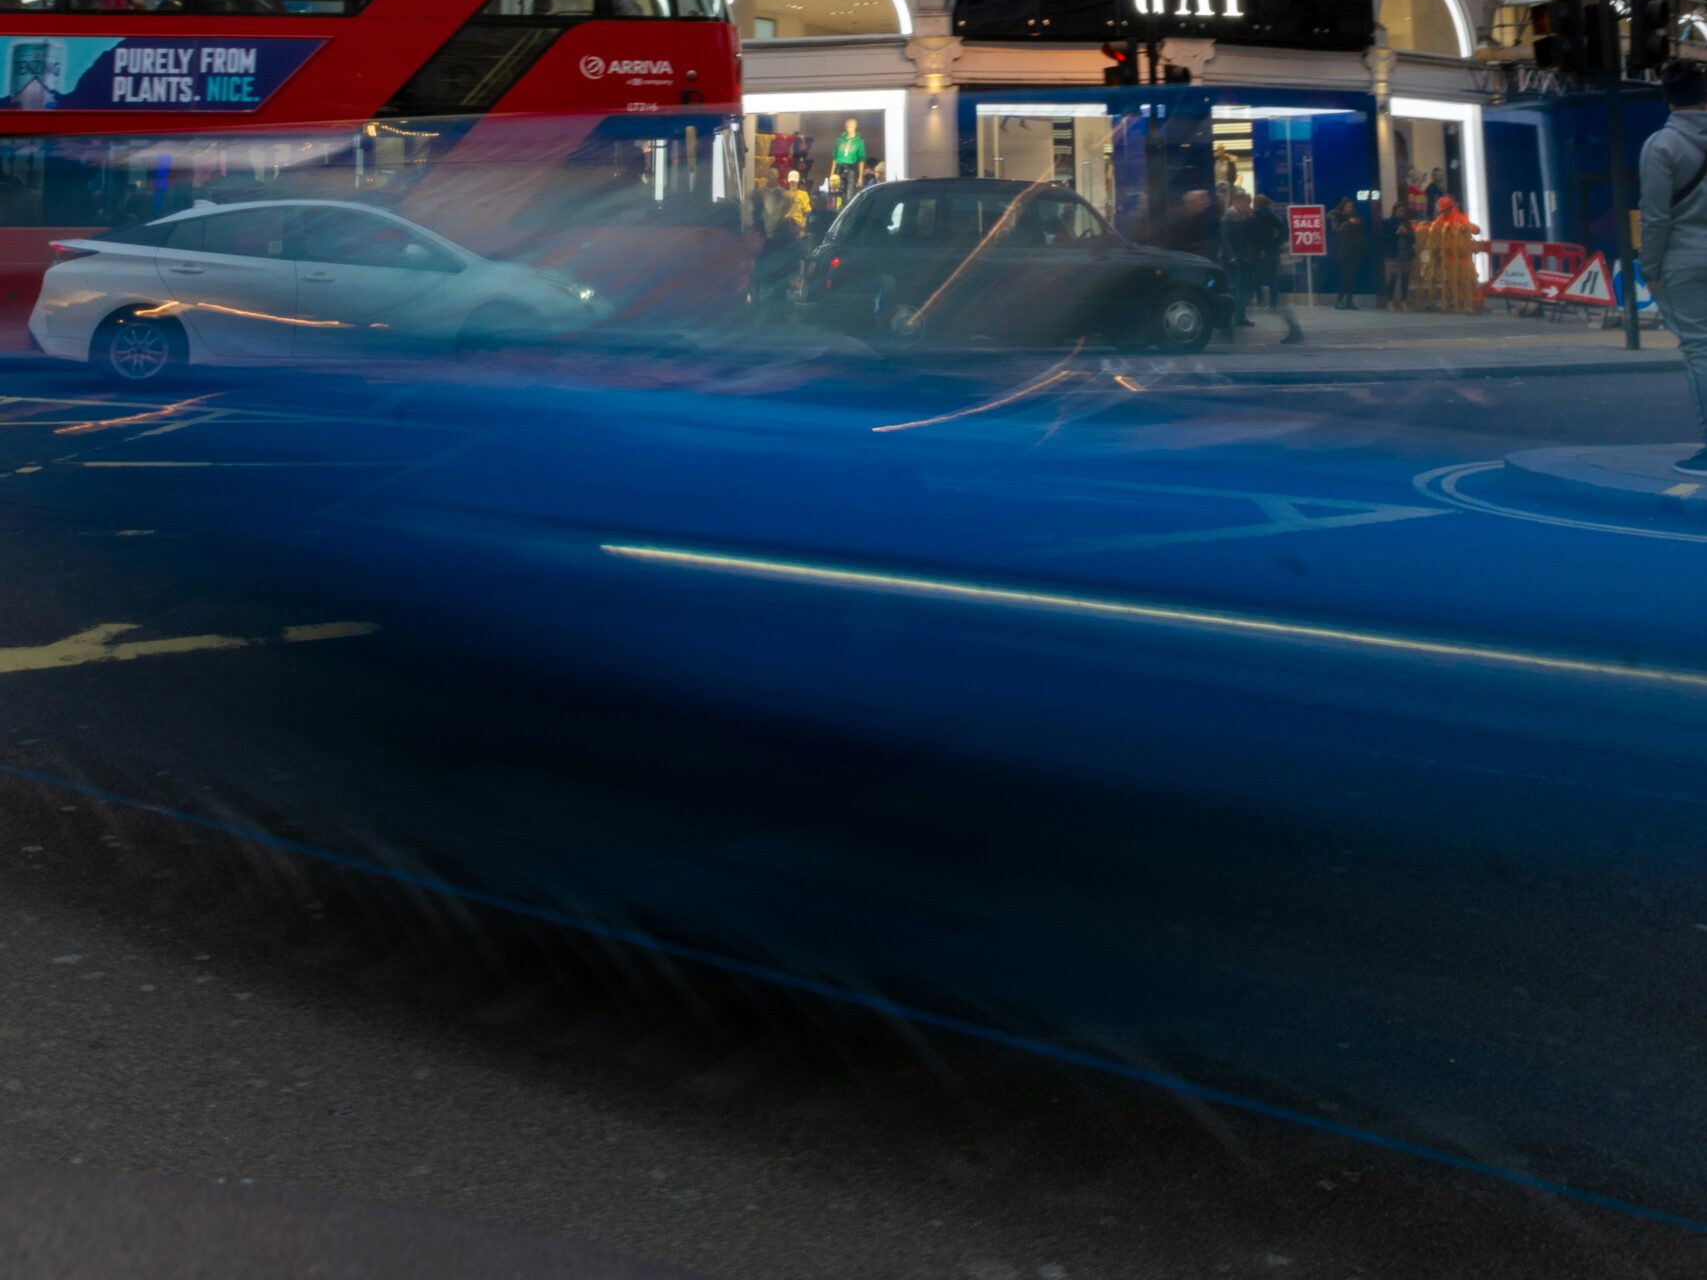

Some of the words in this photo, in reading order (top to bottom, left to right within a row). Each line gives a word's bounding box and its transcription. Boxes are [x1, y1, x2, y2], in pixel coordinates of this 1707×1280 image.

[113, 47, 194, 74] PURELY
[200, 47, 258, 74] FROM
[606, 59, 675, 75] ARRIVA
[112, 75, 202, 103] PLANTS.
[205, 75, 261, 103] NICE.
[1511, 190, 1557, 229] GAP
[1292, 218, 1321, 229] SALE
